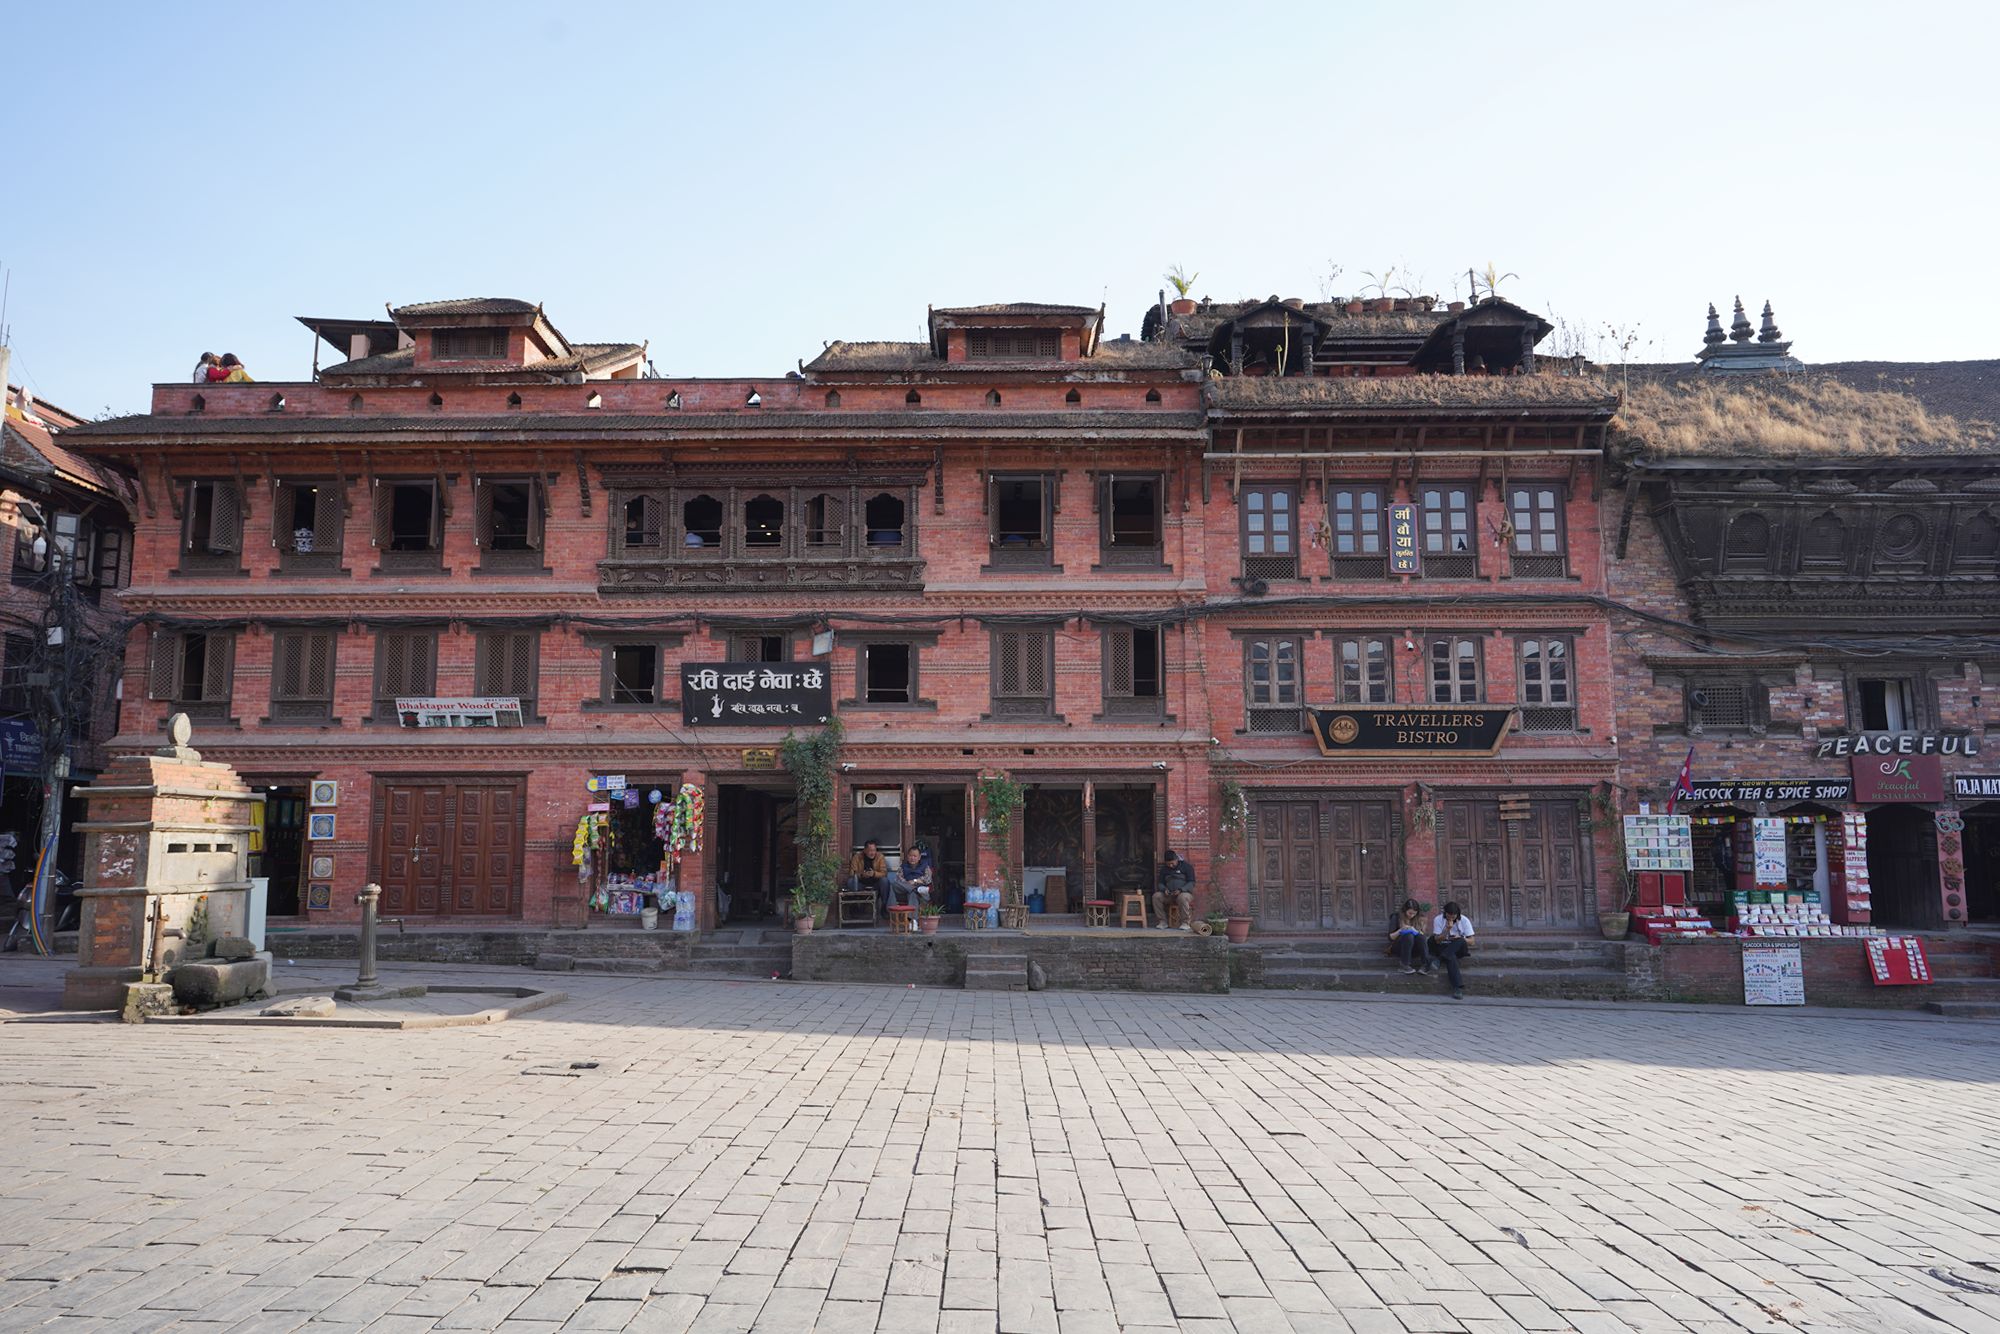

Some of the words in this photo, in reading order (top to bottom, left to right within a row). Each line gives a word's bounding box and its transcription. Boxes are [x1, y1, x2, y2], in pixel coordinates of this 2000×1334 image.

[688, 669, 719, 691] रवि
[723, 669, 756, 692] दाई
[398, 702, 455, 711] Bhaktapur
[1373, 714, 1485, 727] TRAVELLERS
[1396, 731, 1459, 744] BISTRO
[1817, 735, 1978, 757] PEACEFUL
[1738, 787, 1761, 799] TEA
[1764, 787, 1774, 799] &
[1777, 786, 1811, 799] SPICE
[1815, 785, 1848, 798] SHOP
[1876, 780, 1921, 793] Peaceful
[1955, 779, 1980, 794] TAJA
[1871, 792, 1927, 800] RESTAURANT
